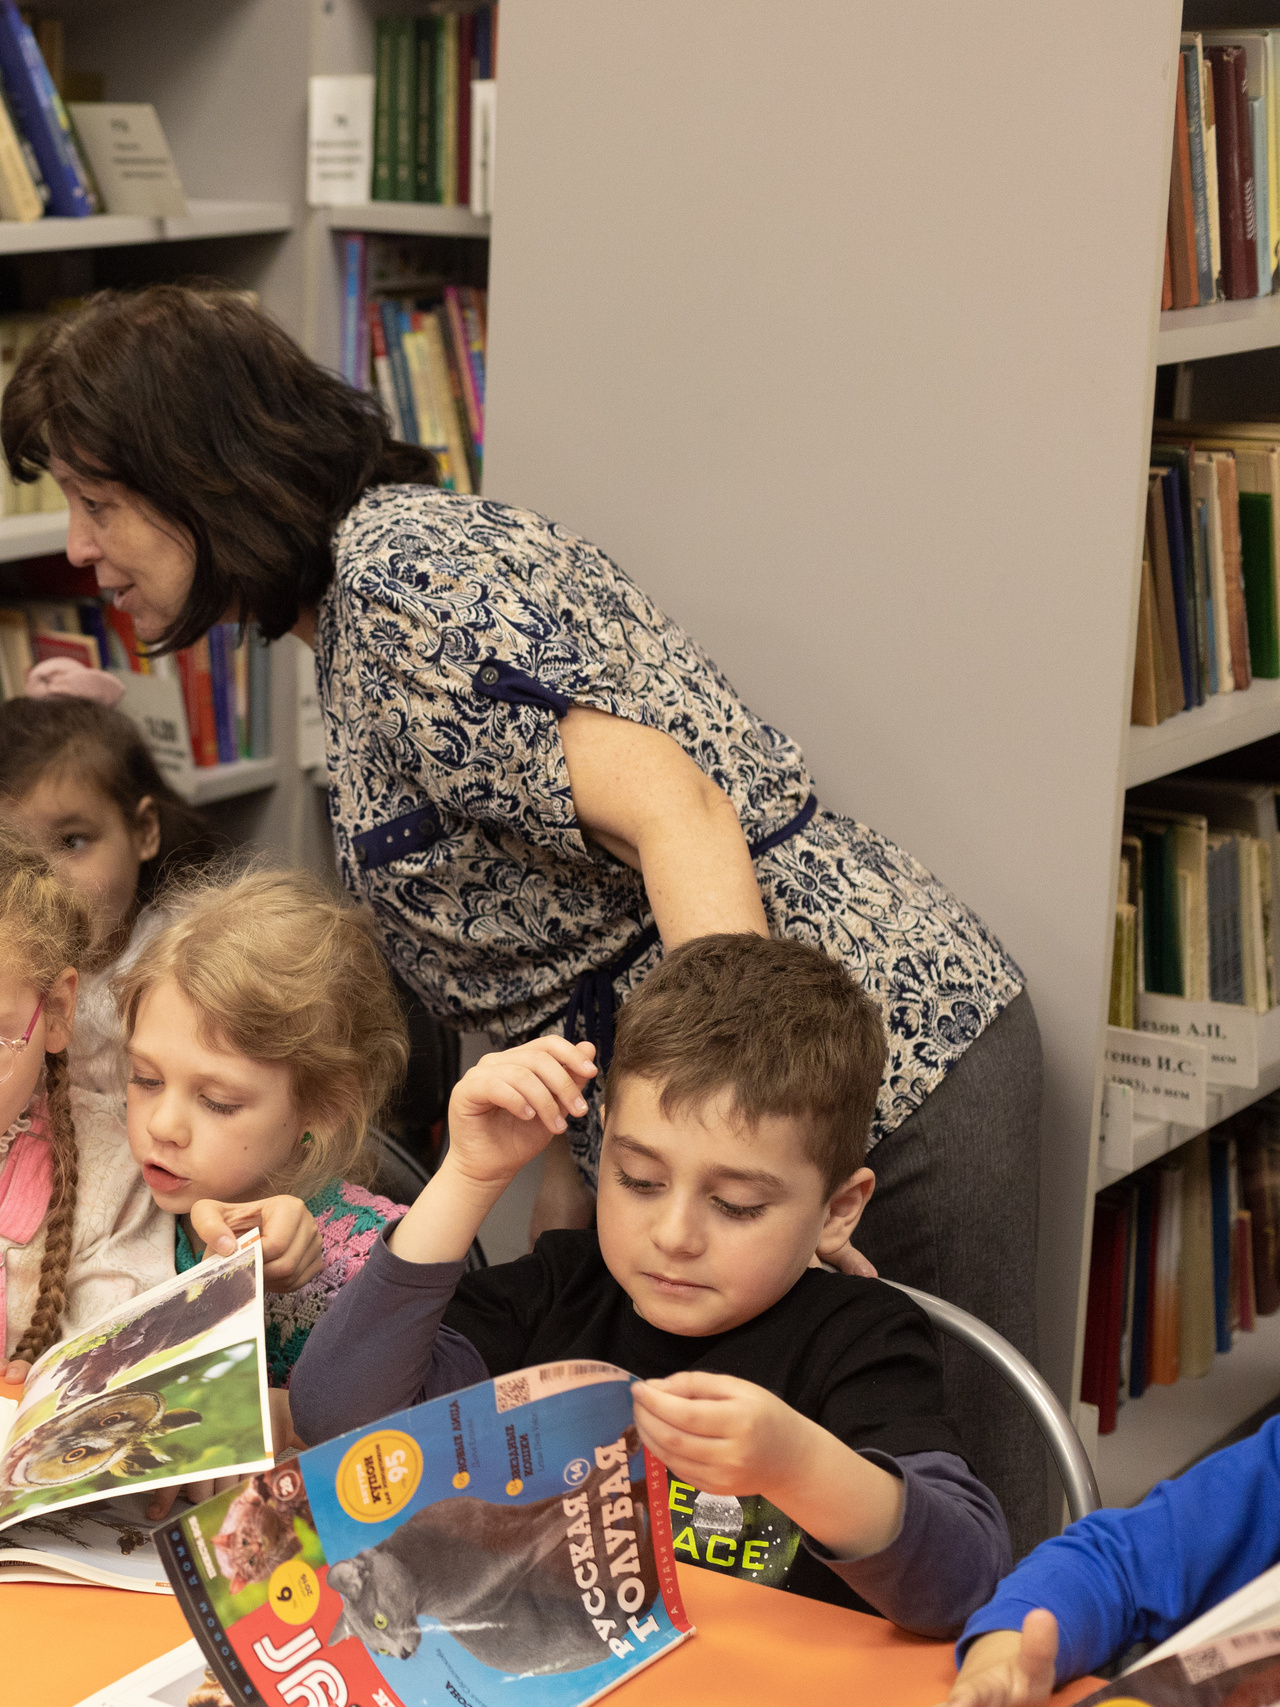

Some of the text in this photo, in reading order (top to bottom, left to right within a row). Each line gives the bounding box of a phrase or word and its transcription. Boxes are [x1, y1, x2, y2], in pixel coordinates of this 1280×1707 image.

[384, 1448, 409, 1484] 95
[593, 1437, 661, 1644] ГОЛУБАЯ
[671, 1525, 770, 1571] ACE
[562, 1491, 636, 1660] РУССКАЯ
[659, 1546, 675, 1595] судьи
[276, 1586, 293, 1602] 6
[670, 1605, 679, 1615] А
